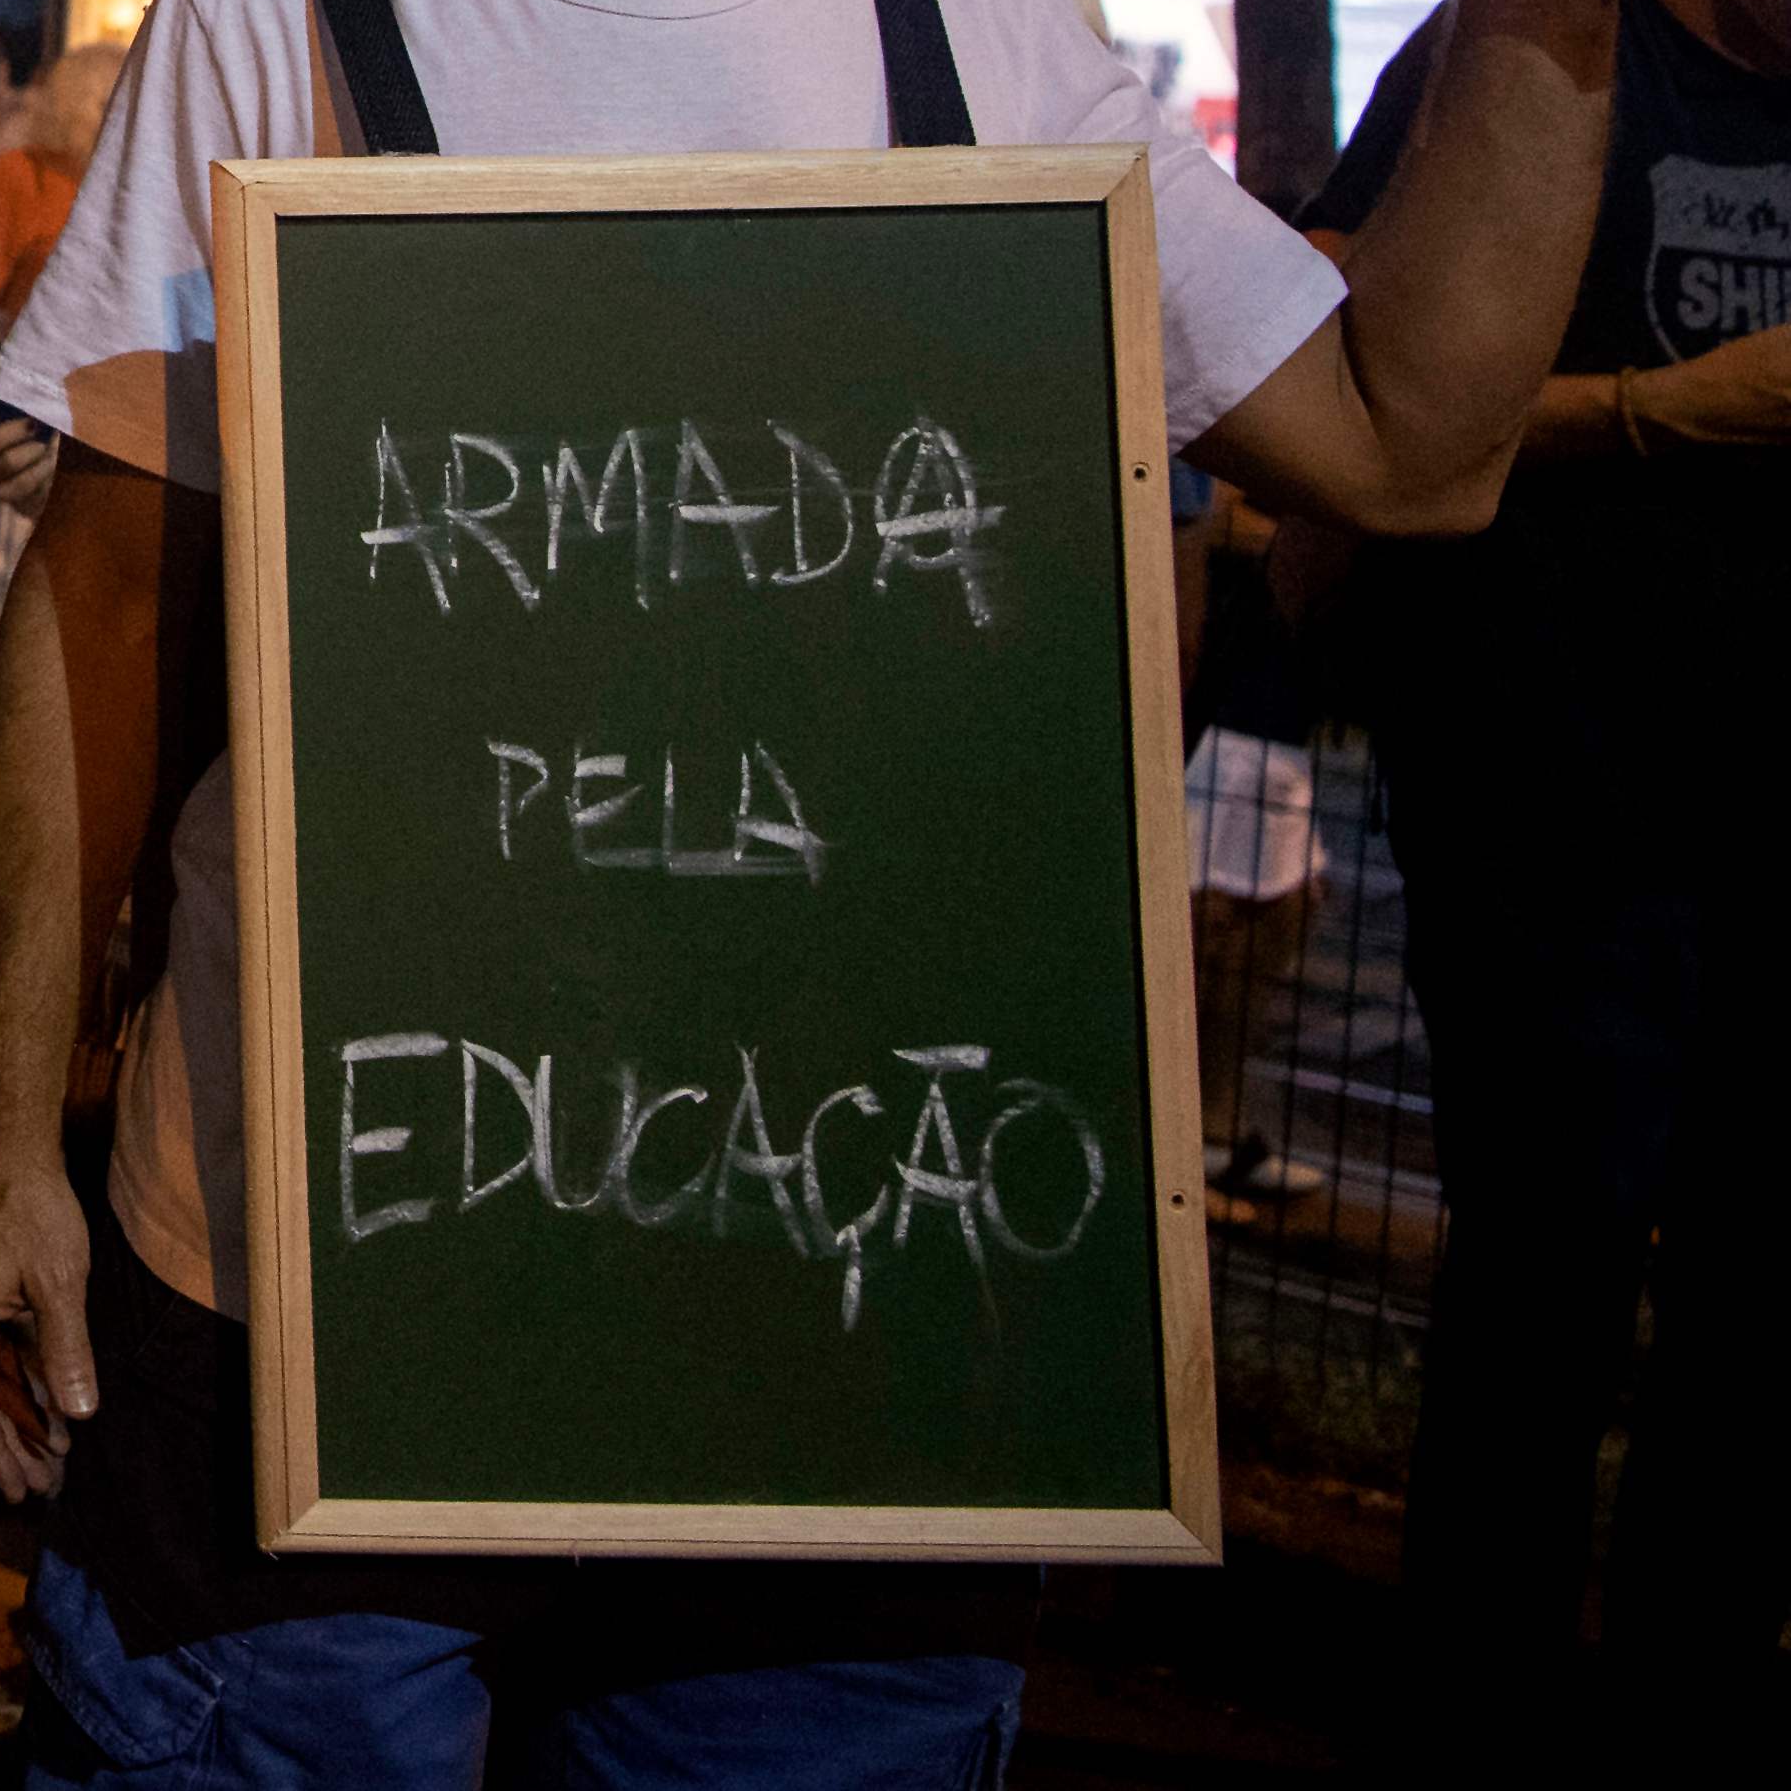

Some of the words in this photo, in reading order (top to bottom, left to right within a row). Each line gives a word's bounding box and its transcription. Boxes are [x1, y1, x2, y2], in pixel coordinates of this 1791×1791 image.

[1677, 255, 1791, 333] SHI
[360, 418, 1007, 629] ARMADA
[486, 737, 829, 884] PELA
[339, 1030, 1105, 1332] EDUCAÇÃO
